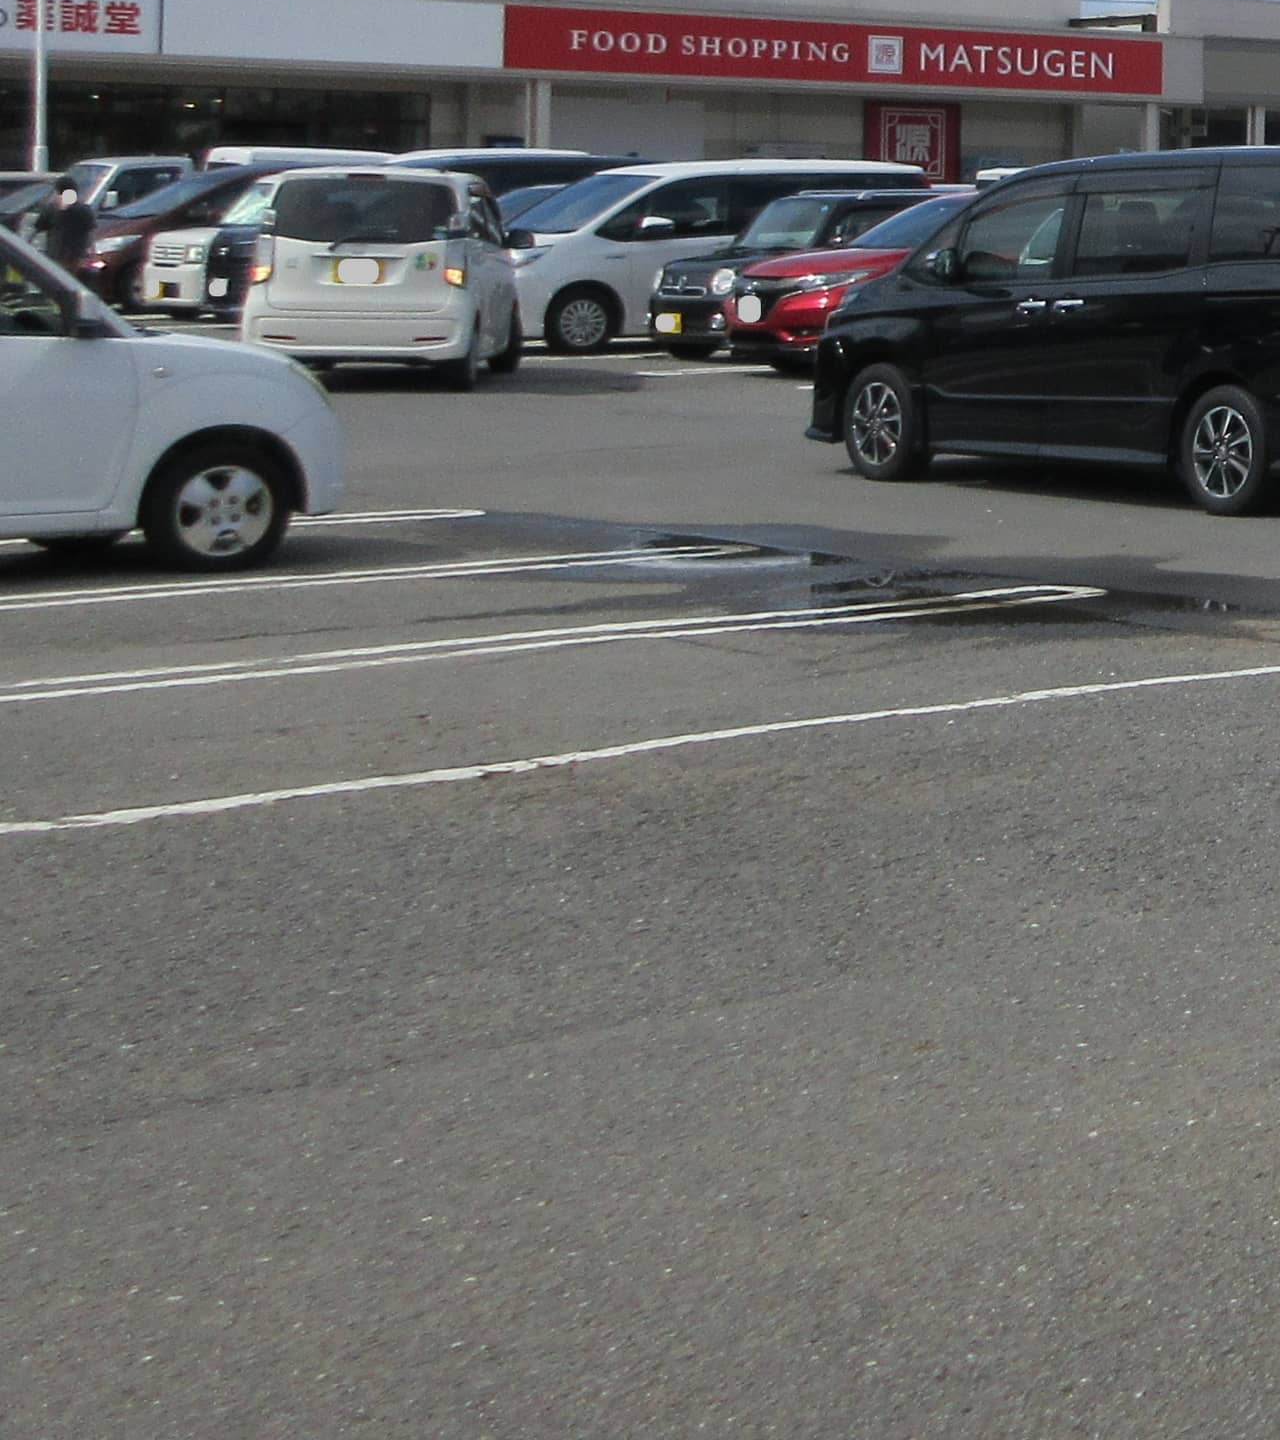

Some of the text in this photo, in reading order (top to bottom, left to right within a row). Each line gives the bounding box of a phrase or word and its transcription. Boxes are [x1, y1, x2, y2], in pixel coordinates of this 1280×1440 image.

[569, 29, 851, 63] FOOD SHOPPING
[919, 42, 1114, 79] MATSUGEN
